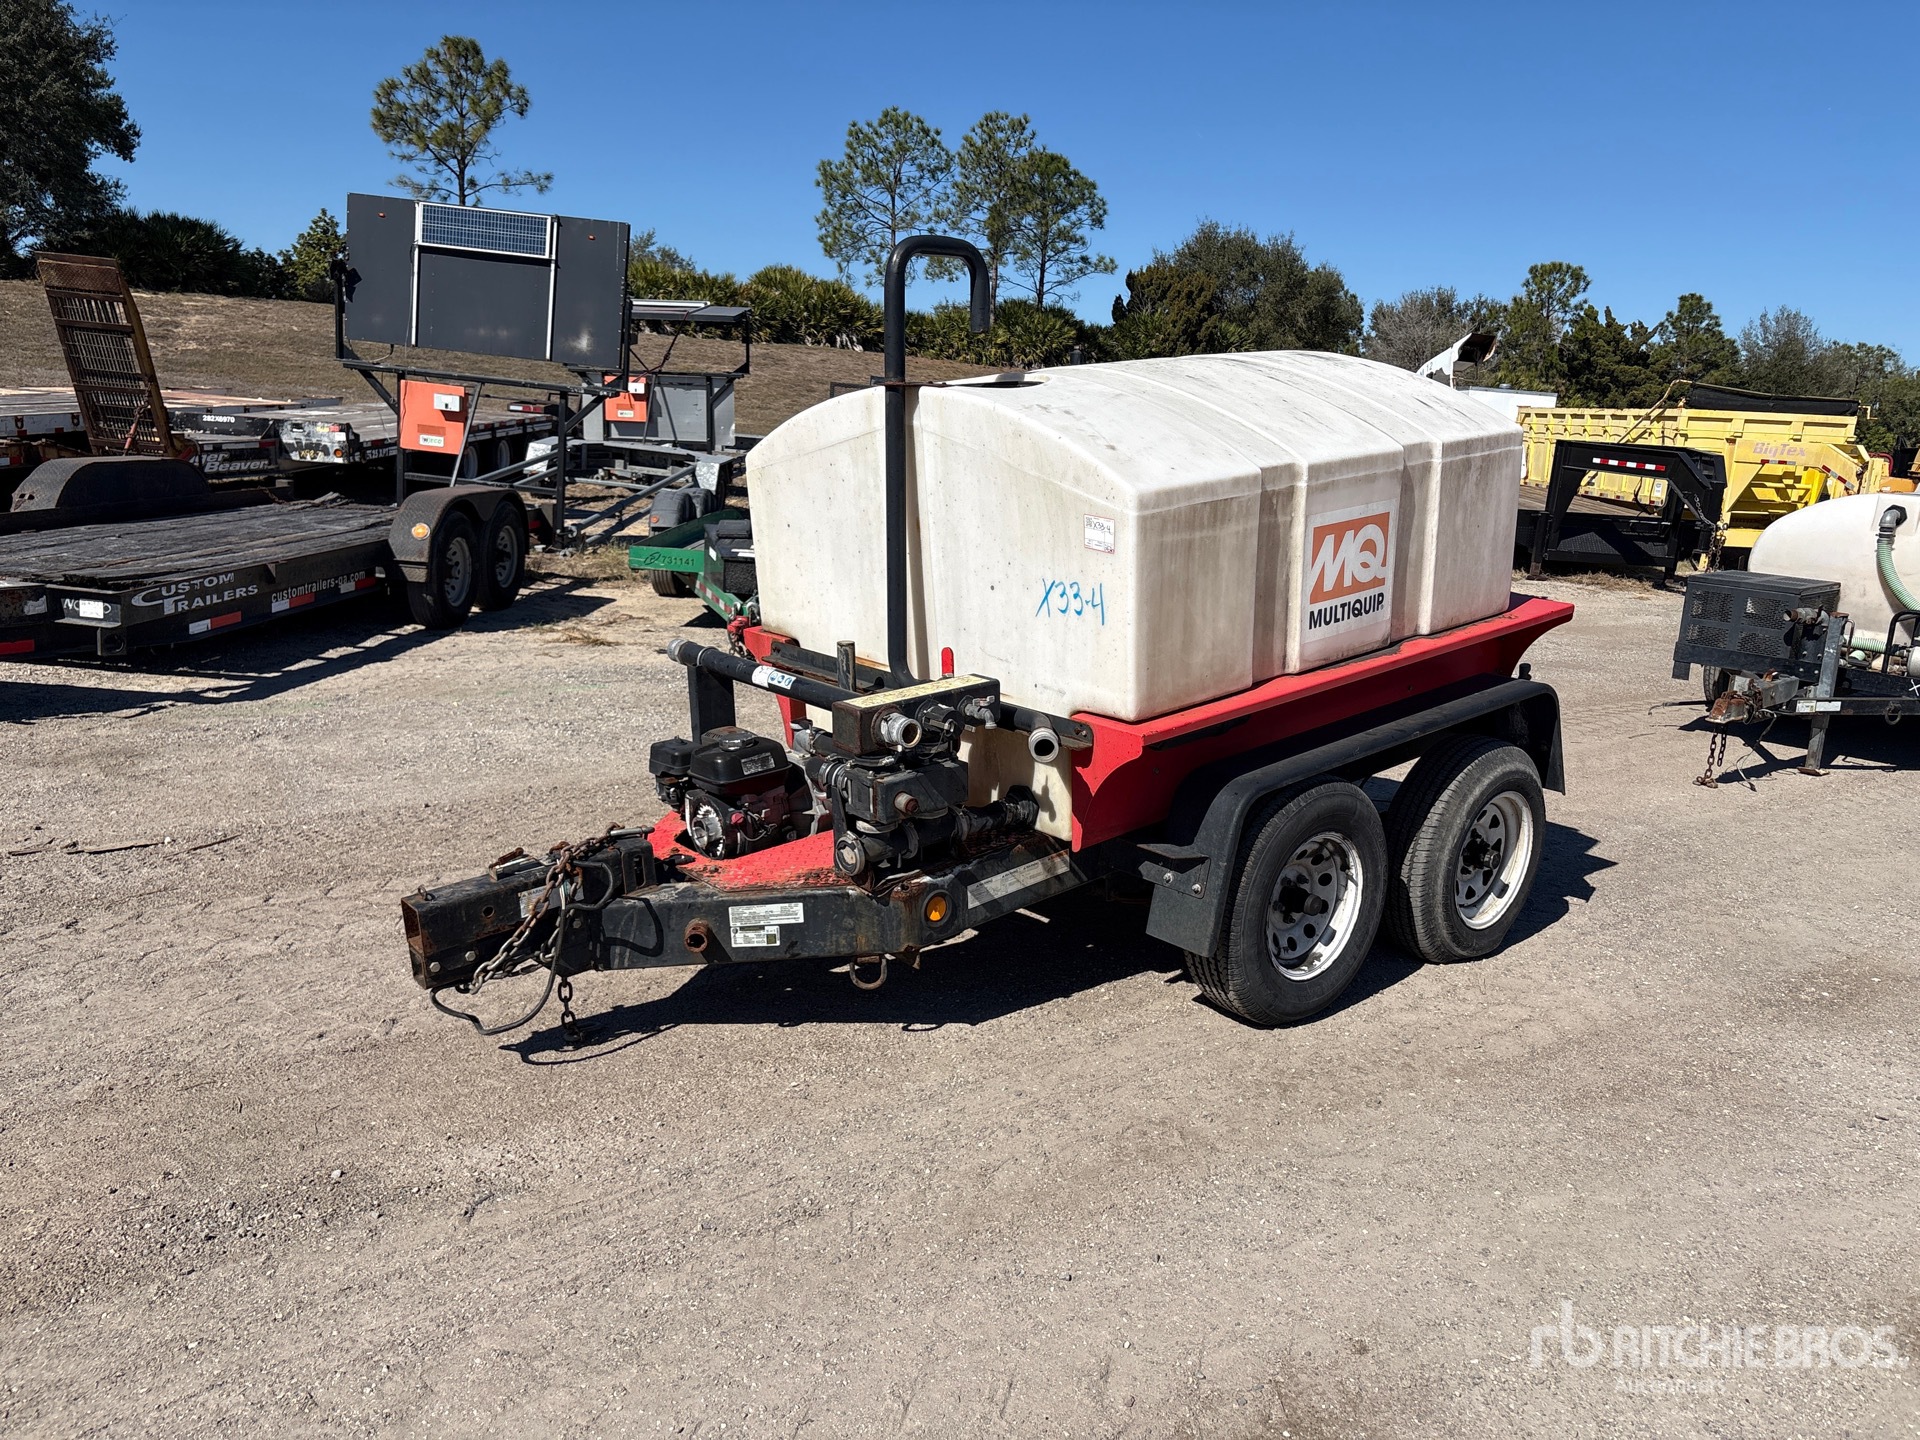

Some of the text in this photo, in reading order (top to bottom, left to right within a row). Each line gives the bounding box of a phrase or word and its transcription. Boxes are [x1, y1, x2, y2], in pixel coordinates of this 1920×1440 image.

[204, 461, 269, 473] Beaver
[662, 555, 696, 567] 731141
[1310, 524, 1387, 592] MQ
[162, 584, 259, 615] TRAILERS
[1035, 578, 1104, 626] X33-4
[1309, 592, 1385, 630] MULTIQUIP
